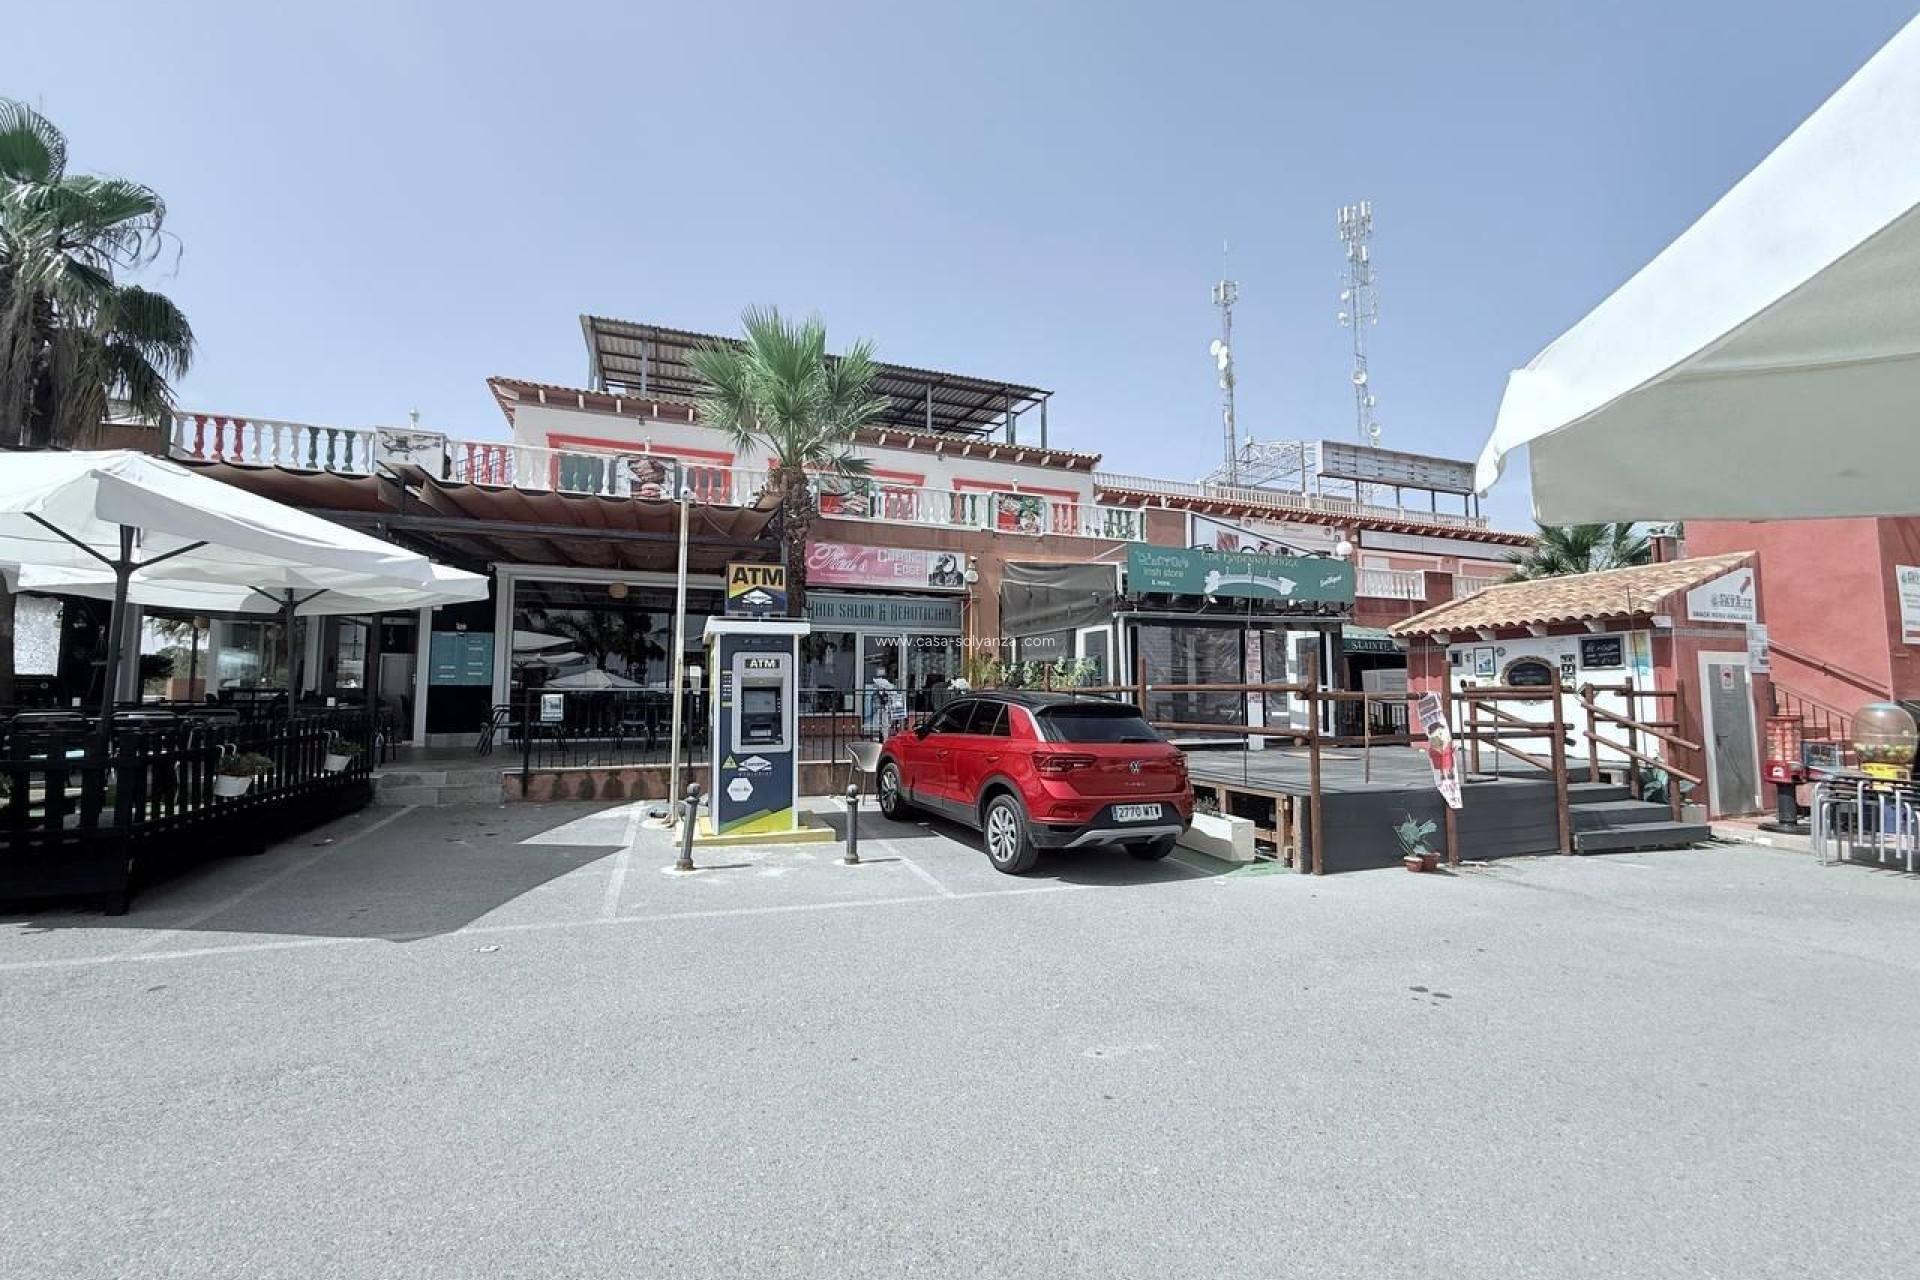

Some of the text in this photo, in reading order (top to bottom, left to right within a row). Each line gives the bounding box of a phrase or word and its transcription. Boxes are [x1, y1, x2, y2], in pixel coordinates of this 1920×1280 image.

[732, 567, 784, 586] ATM
[1163, 568, 1184, 578] store
[839, 603, 874, 619] SALON
[891, 604, 951, 622] BEAUTICIAN
[750, 659, 776, 668] ATM
